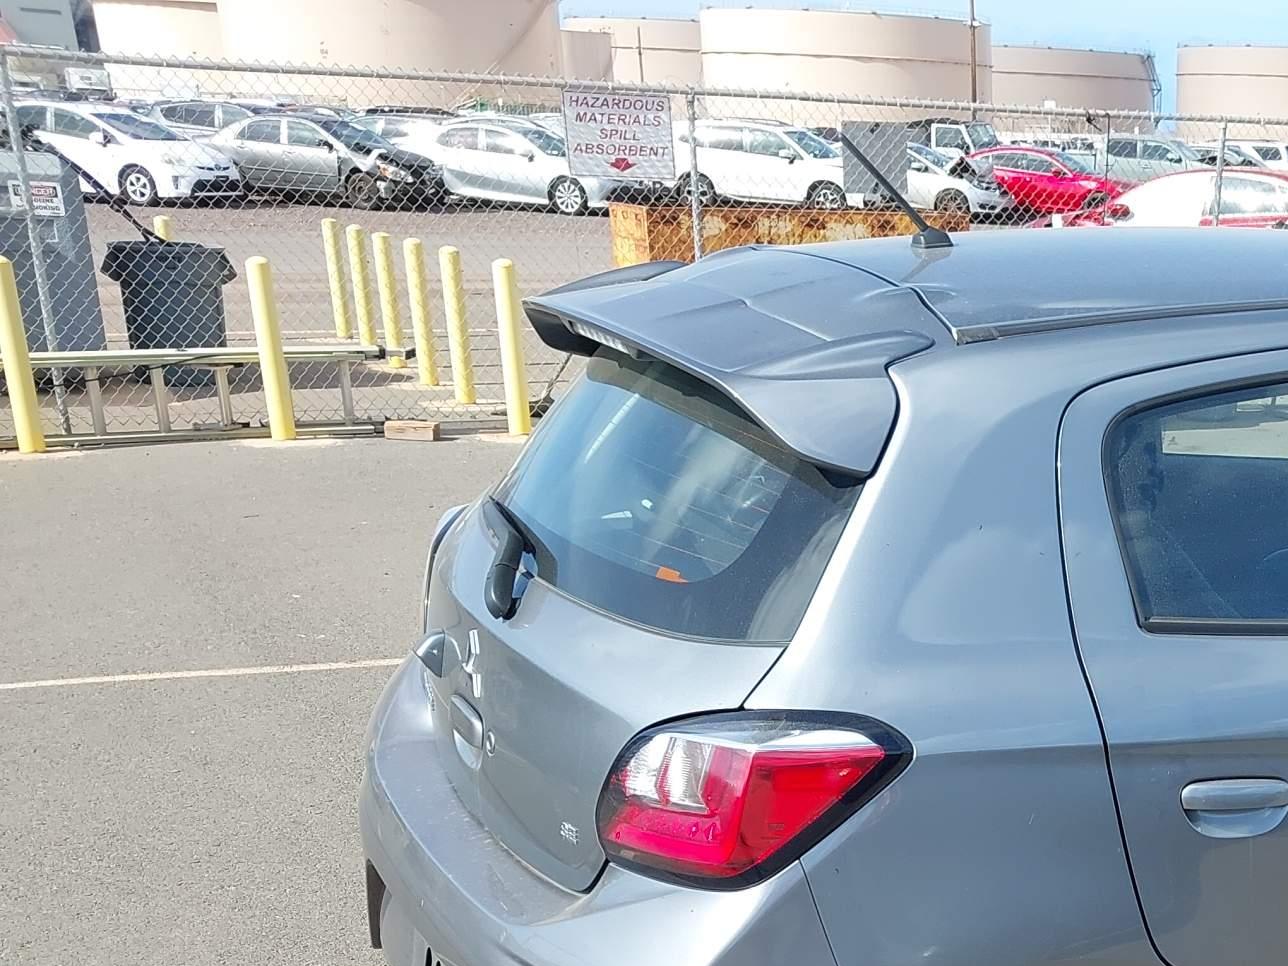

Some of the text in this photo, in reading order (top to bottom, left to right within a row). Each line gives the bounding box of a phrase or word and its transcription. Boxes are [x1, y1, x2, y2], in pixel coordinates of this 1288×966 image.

[569, 95, 665, 112] HAZARDOUS
[574, 111, 662, 128] MATERIALS
[598, 127, 641, 142] SPILL
[572, 143, 669, 158] ABSORBENT
